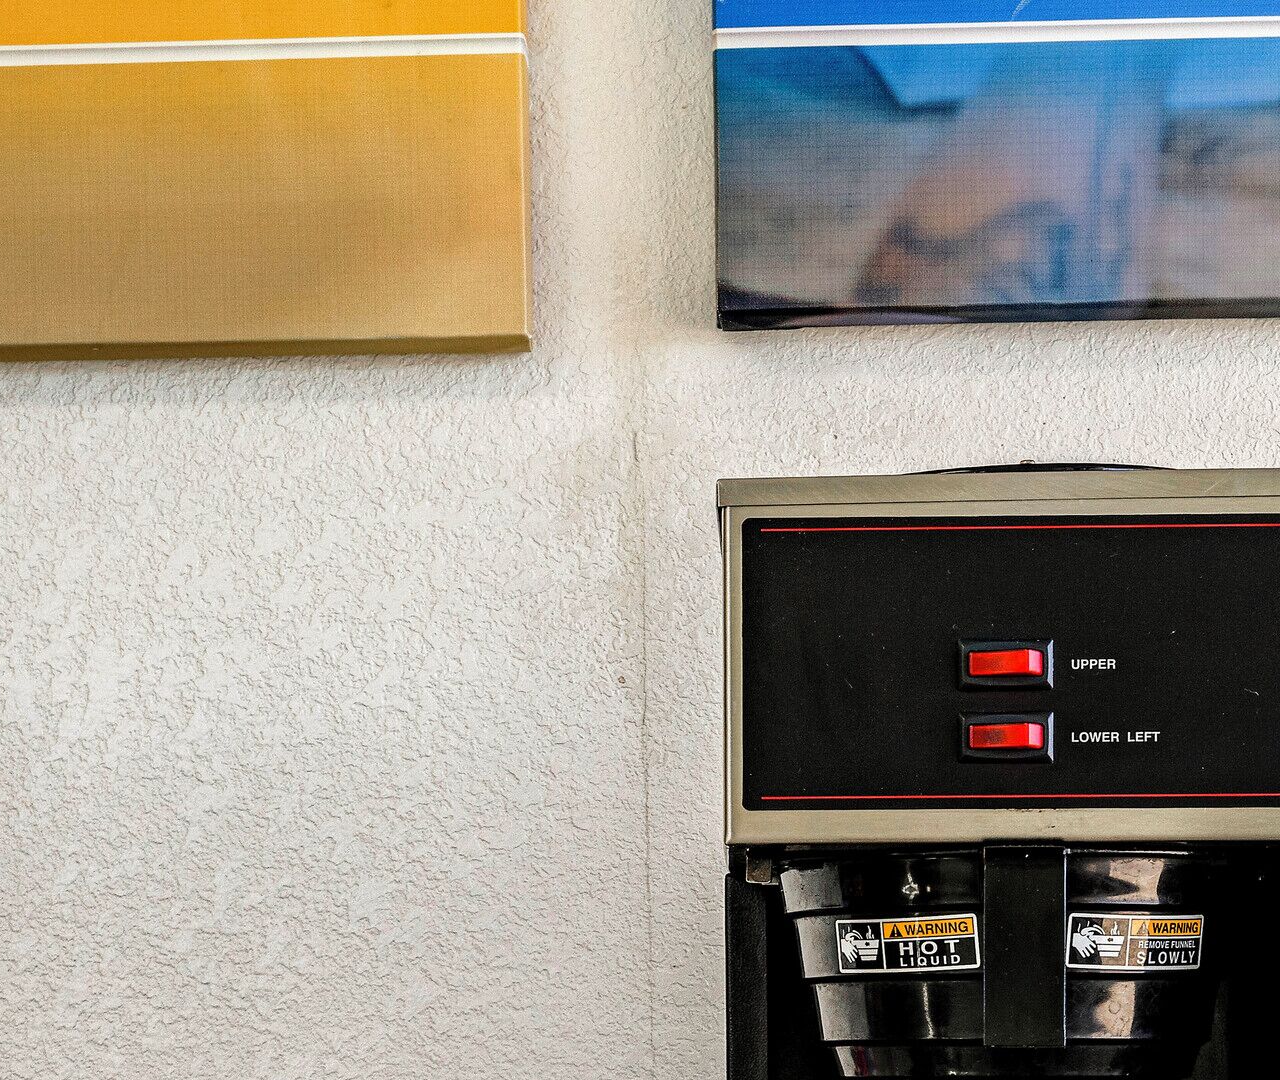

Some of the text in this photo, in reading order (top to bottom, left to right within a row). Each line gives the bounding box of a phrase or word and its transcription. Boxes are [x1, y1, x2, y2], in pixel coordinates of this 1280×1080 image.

[1071, 659, 1116, 670] UPPER
[1071, 731, 1160, 742] LOWER LEFT
[904, 921, 969, 936] WARNING
[1152, 922, 1199, 933] WARNING
[899, 940, 960, 956] HOT
[1138, 940, 1196, 949] REMOVE FUNNEL
[900, 955, 961, 967] LIQUID
[1136, 951, 1196, 964] SLOWLY
